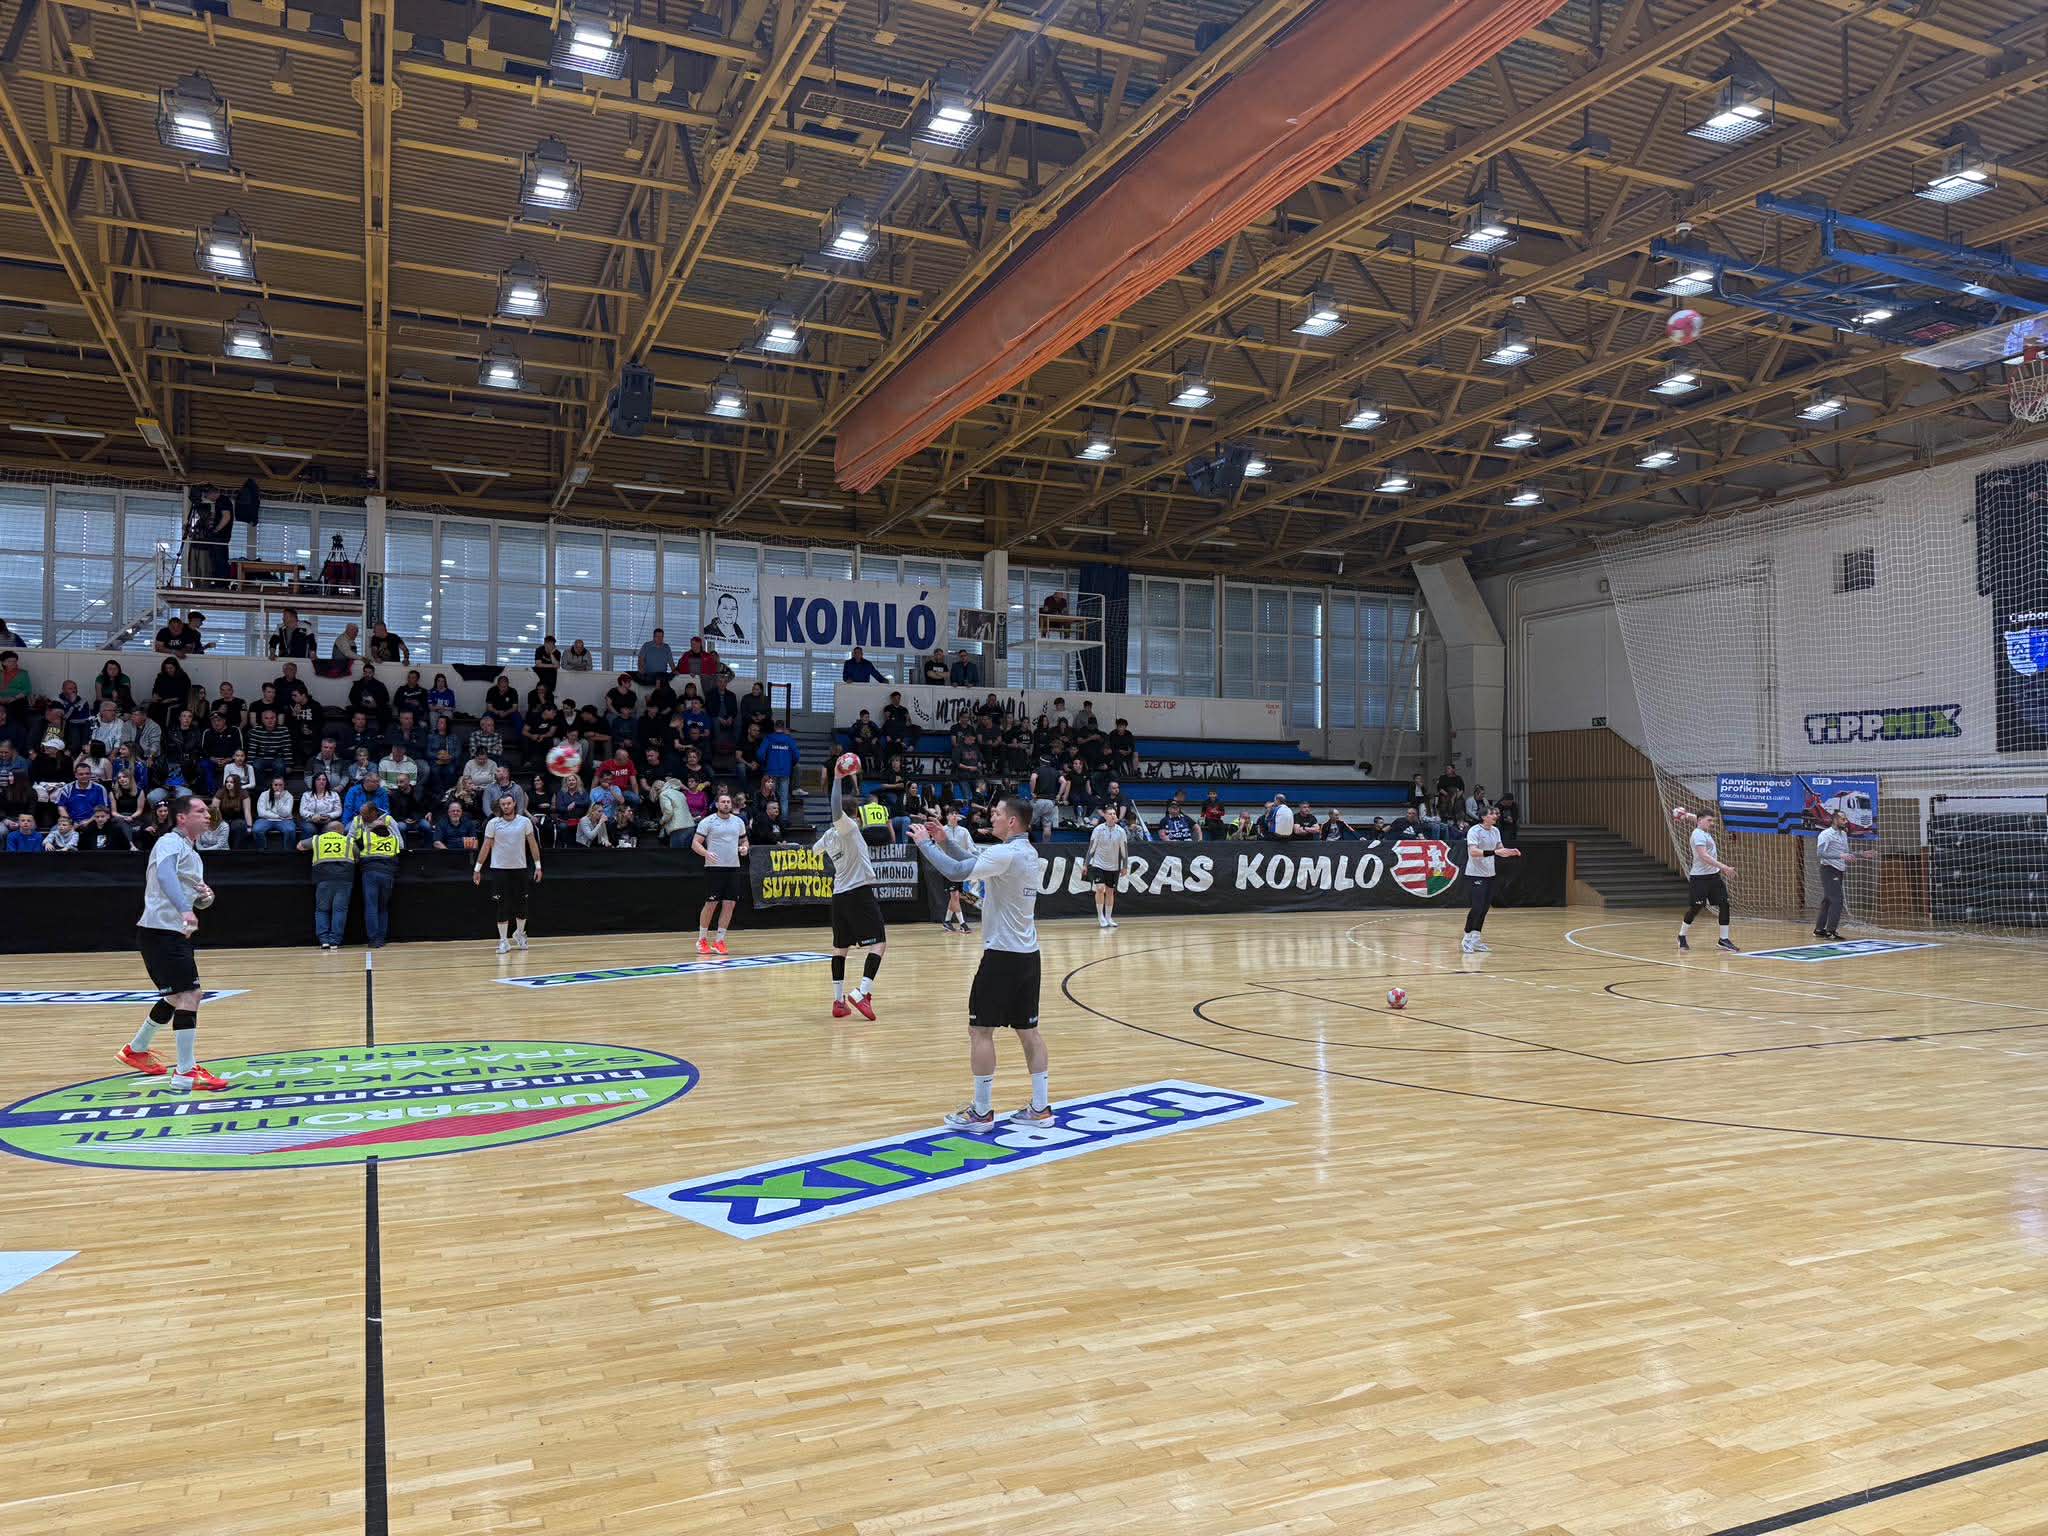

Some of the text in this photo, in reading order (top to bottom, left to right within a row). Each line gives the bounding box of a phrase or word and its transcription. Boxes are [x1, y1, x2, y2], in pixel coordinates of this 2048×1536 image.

[774, 591, 937, 650] KOMLÓ
[1720, 785, 1772, 794] profiknak
[870, 812, 883, 821] 10
[324, 842, 341, 853] 23
[376, 841, 392, 852] 26
[1037, 840, 1384, 896] ULRAS KOMLÓ
[246, 1045, 491, 1066] KERÍTÉS
[127, 1048, 589, 1087] TRAPÉZLEMZ
[57, 1070, 646, 1121] hungarometal.hu
